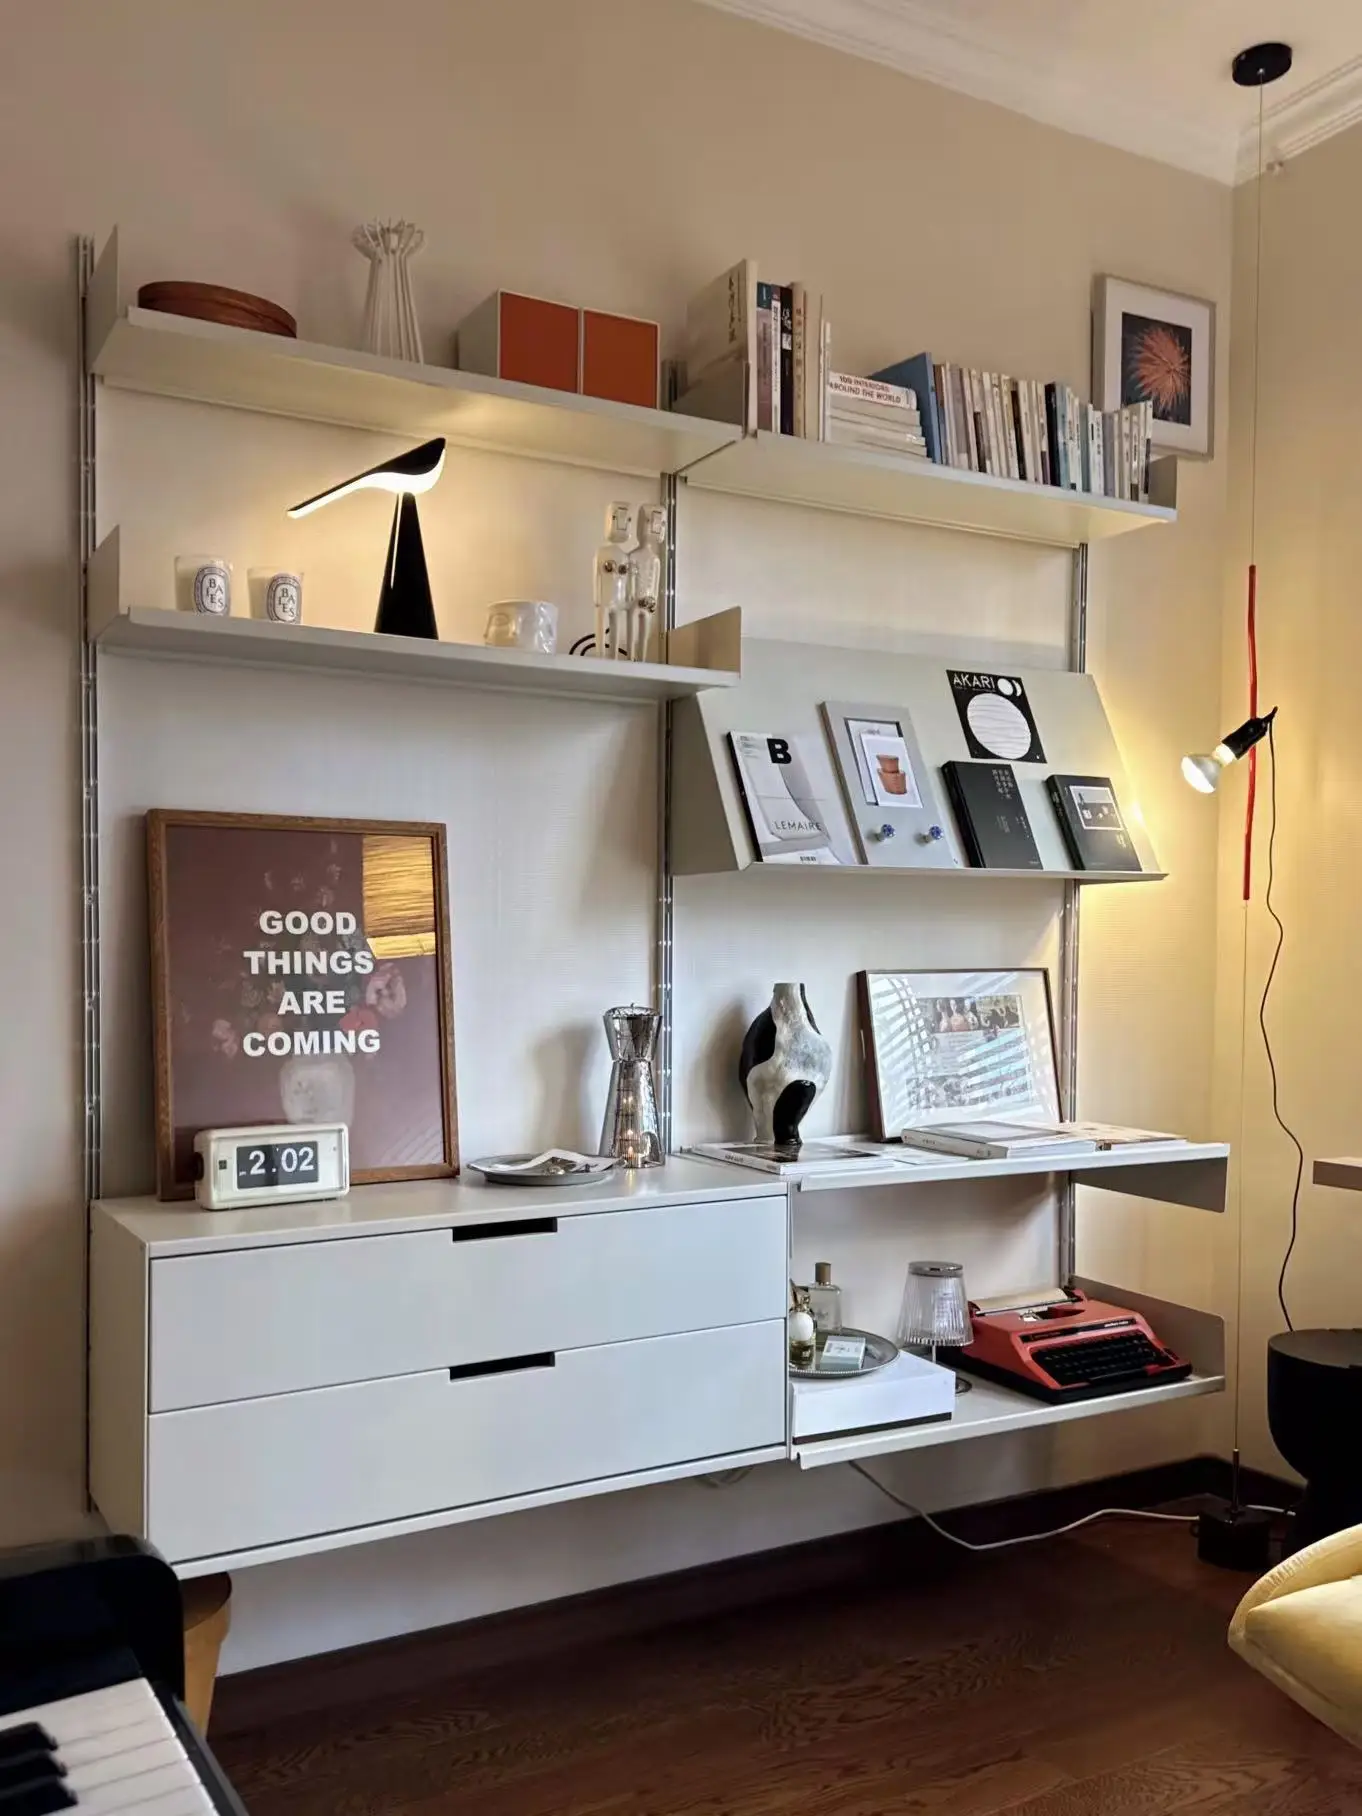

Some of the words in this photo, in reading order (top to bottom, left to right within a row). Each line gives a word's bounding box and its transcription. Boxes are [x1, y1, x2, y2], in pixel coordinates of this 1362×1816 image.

[829, 382, 860, 395] AROUND
[862, 388, 875, 399] THE
[876, 392, 901, 403] WORLD
[953, 672, 996, 689] AKARI
[766, 737, 792, 764] B
[774, 820, 822, 831] LEMAIRE
[259, 910, 357, 935] GOOD
[243, 951, 375, 975] THINGS
[277, 990, 346, 1015] ARE
[242, 1029, 381, 1057] COMING
